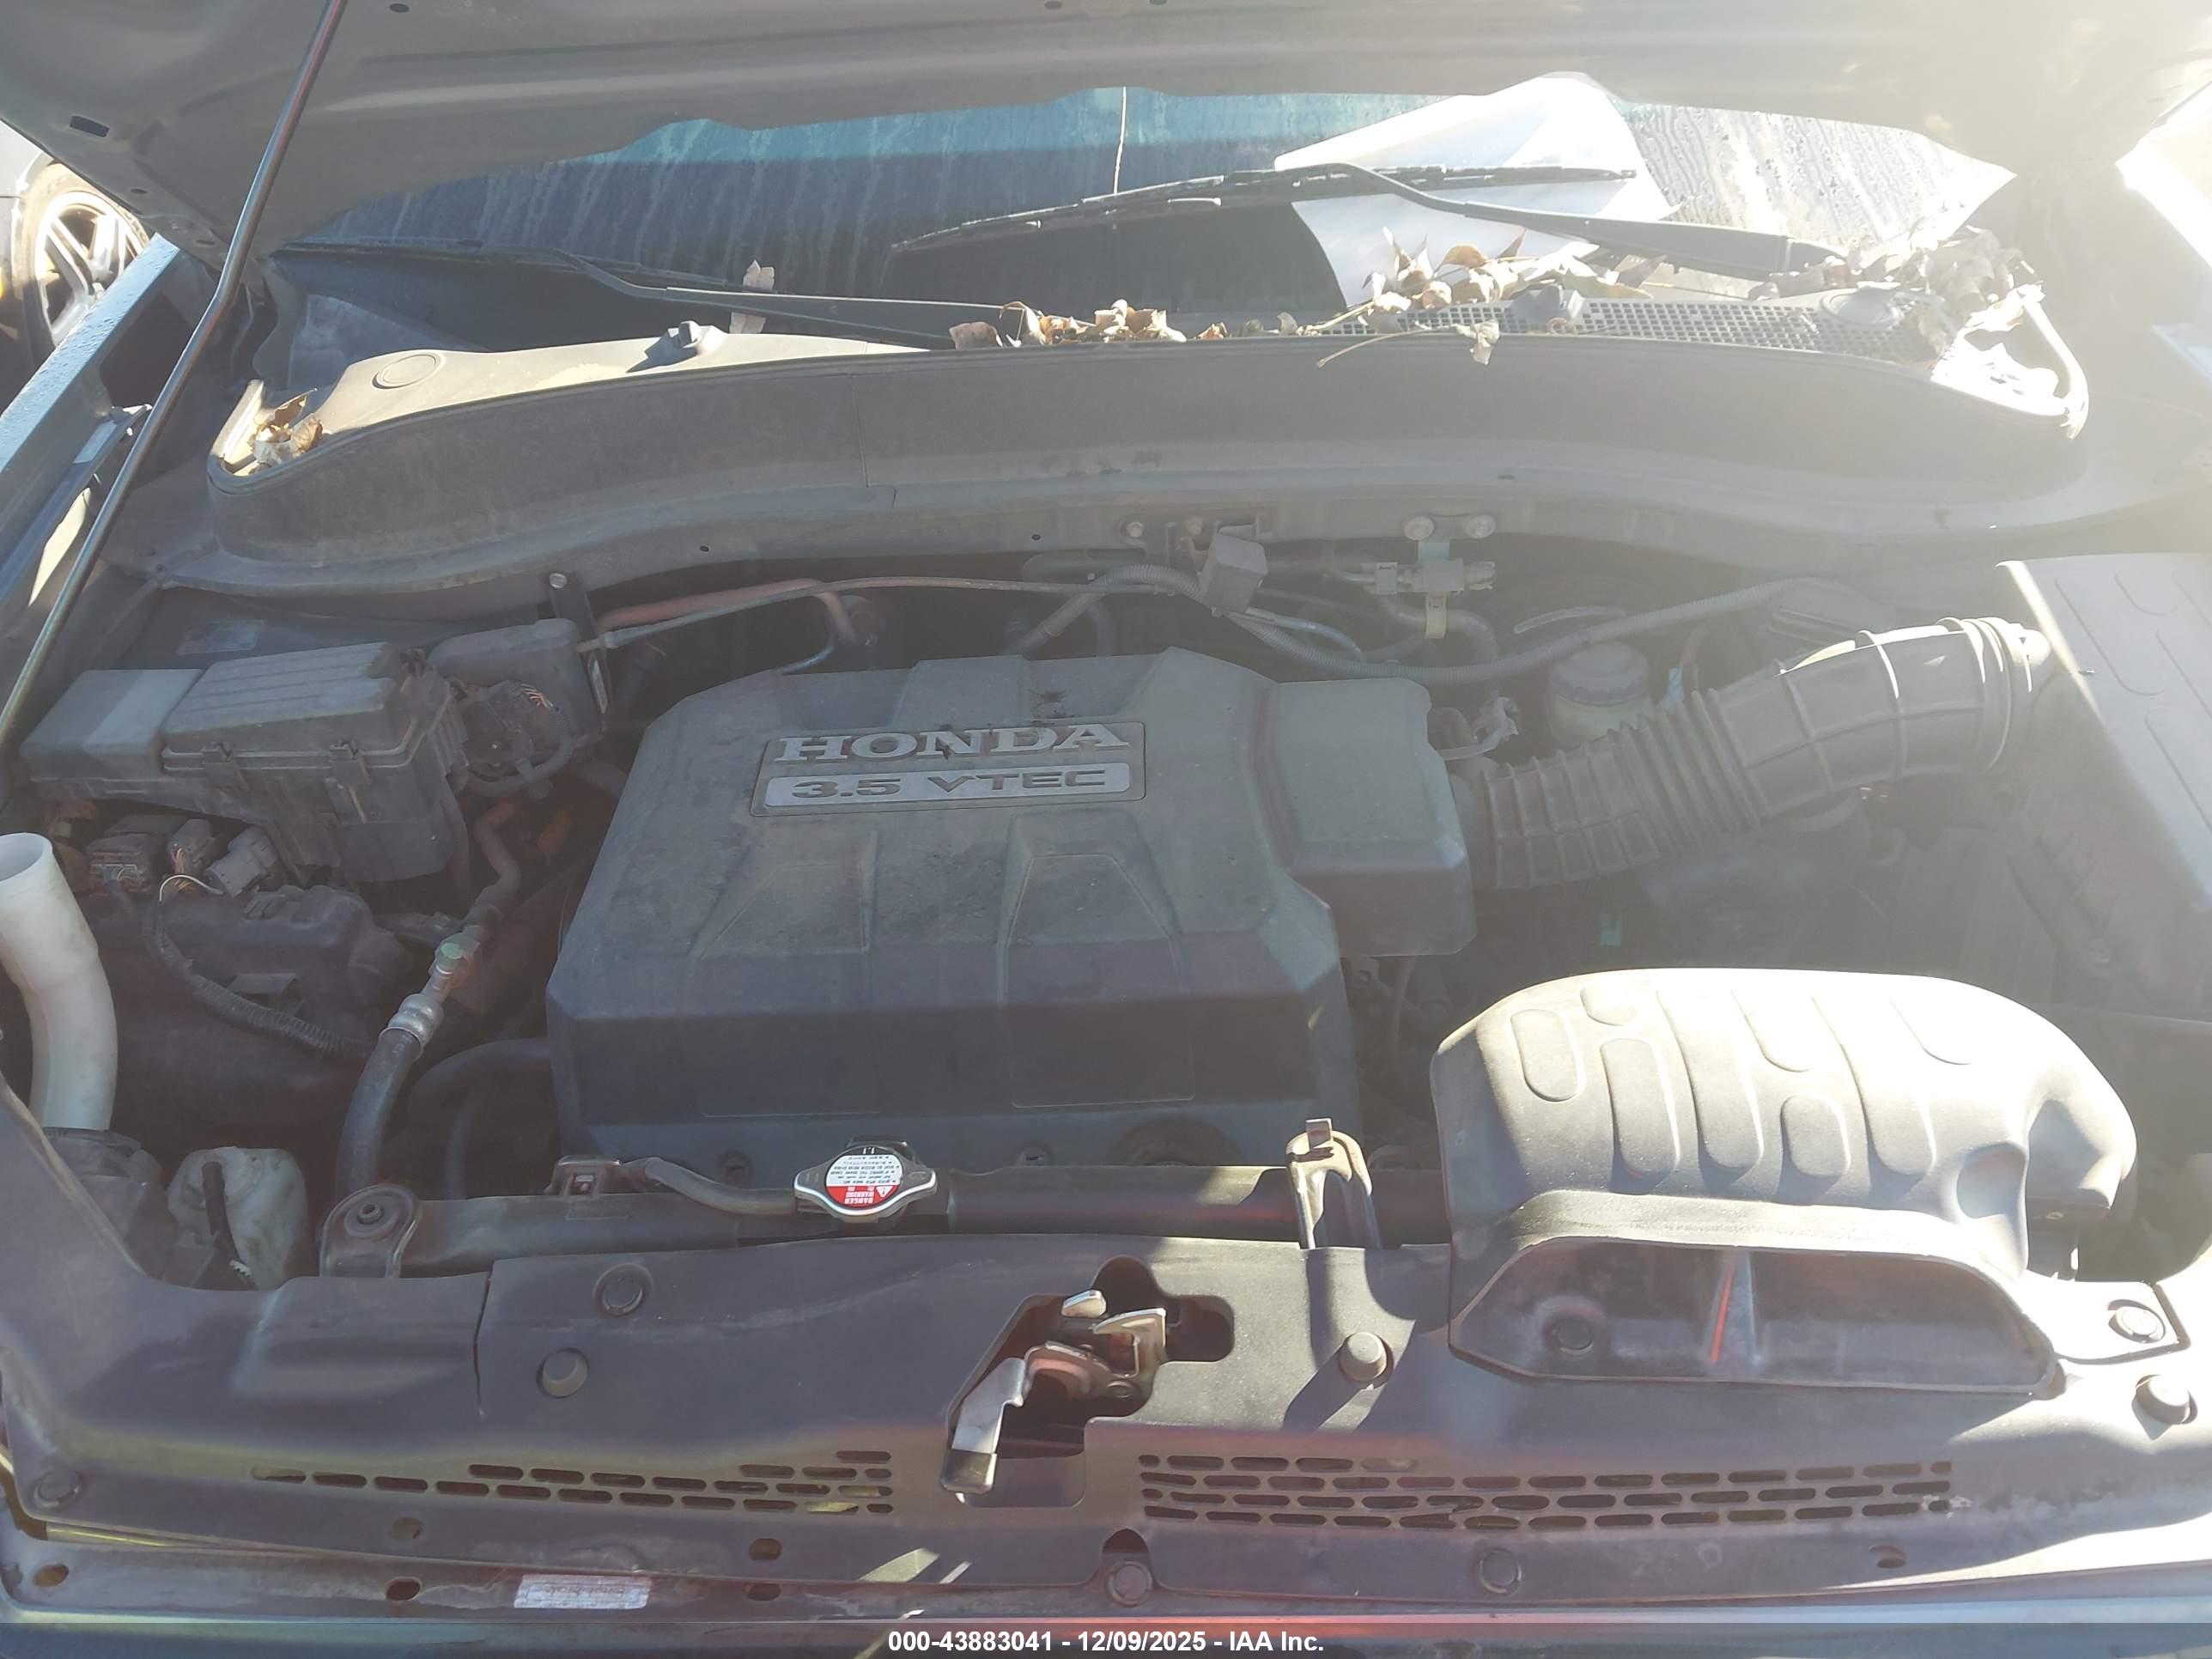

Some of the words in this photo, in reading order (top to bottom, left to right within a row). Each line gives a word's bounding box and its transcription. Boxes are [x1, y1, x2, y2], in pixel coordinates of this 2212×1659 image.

[775, 723, 1132, 763] HONDA
[791, 778, 902, 799] 3.5
[927, 769, 1106, 793] VTEC
